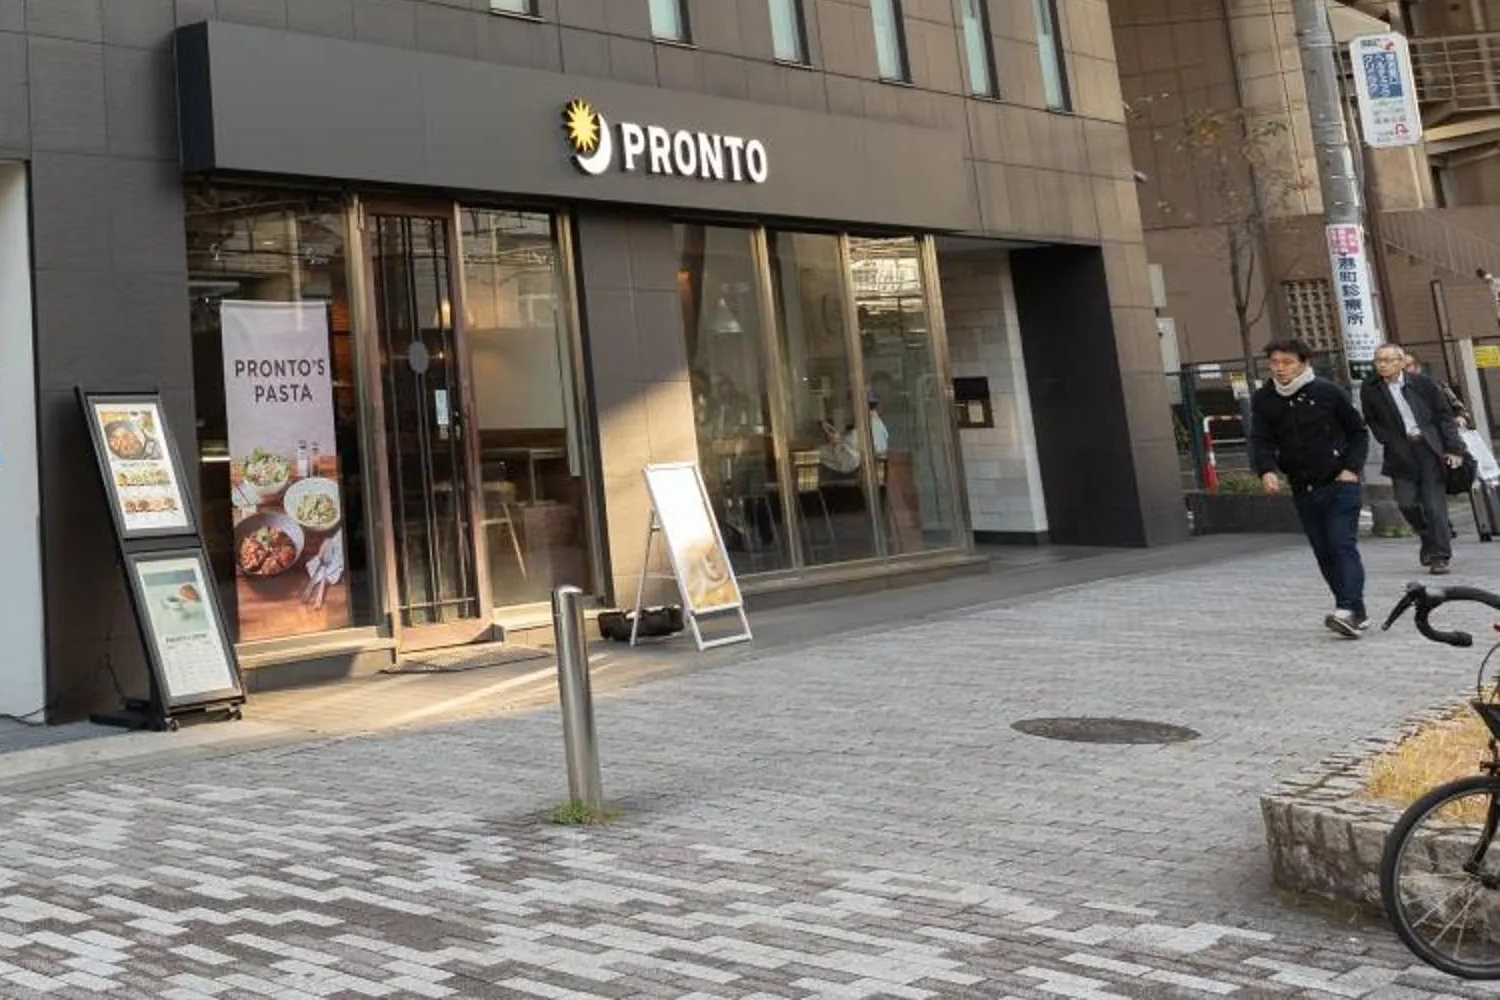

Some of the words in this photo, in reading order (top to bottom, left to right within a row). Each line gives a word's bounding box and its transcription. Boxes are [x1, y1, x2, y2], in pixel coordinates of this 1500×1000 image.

[620, 121, 768, 183] PRONTO
[235, 359, 325, 378] PRONTO'S
[254, 384, 313, 403] PASTA
